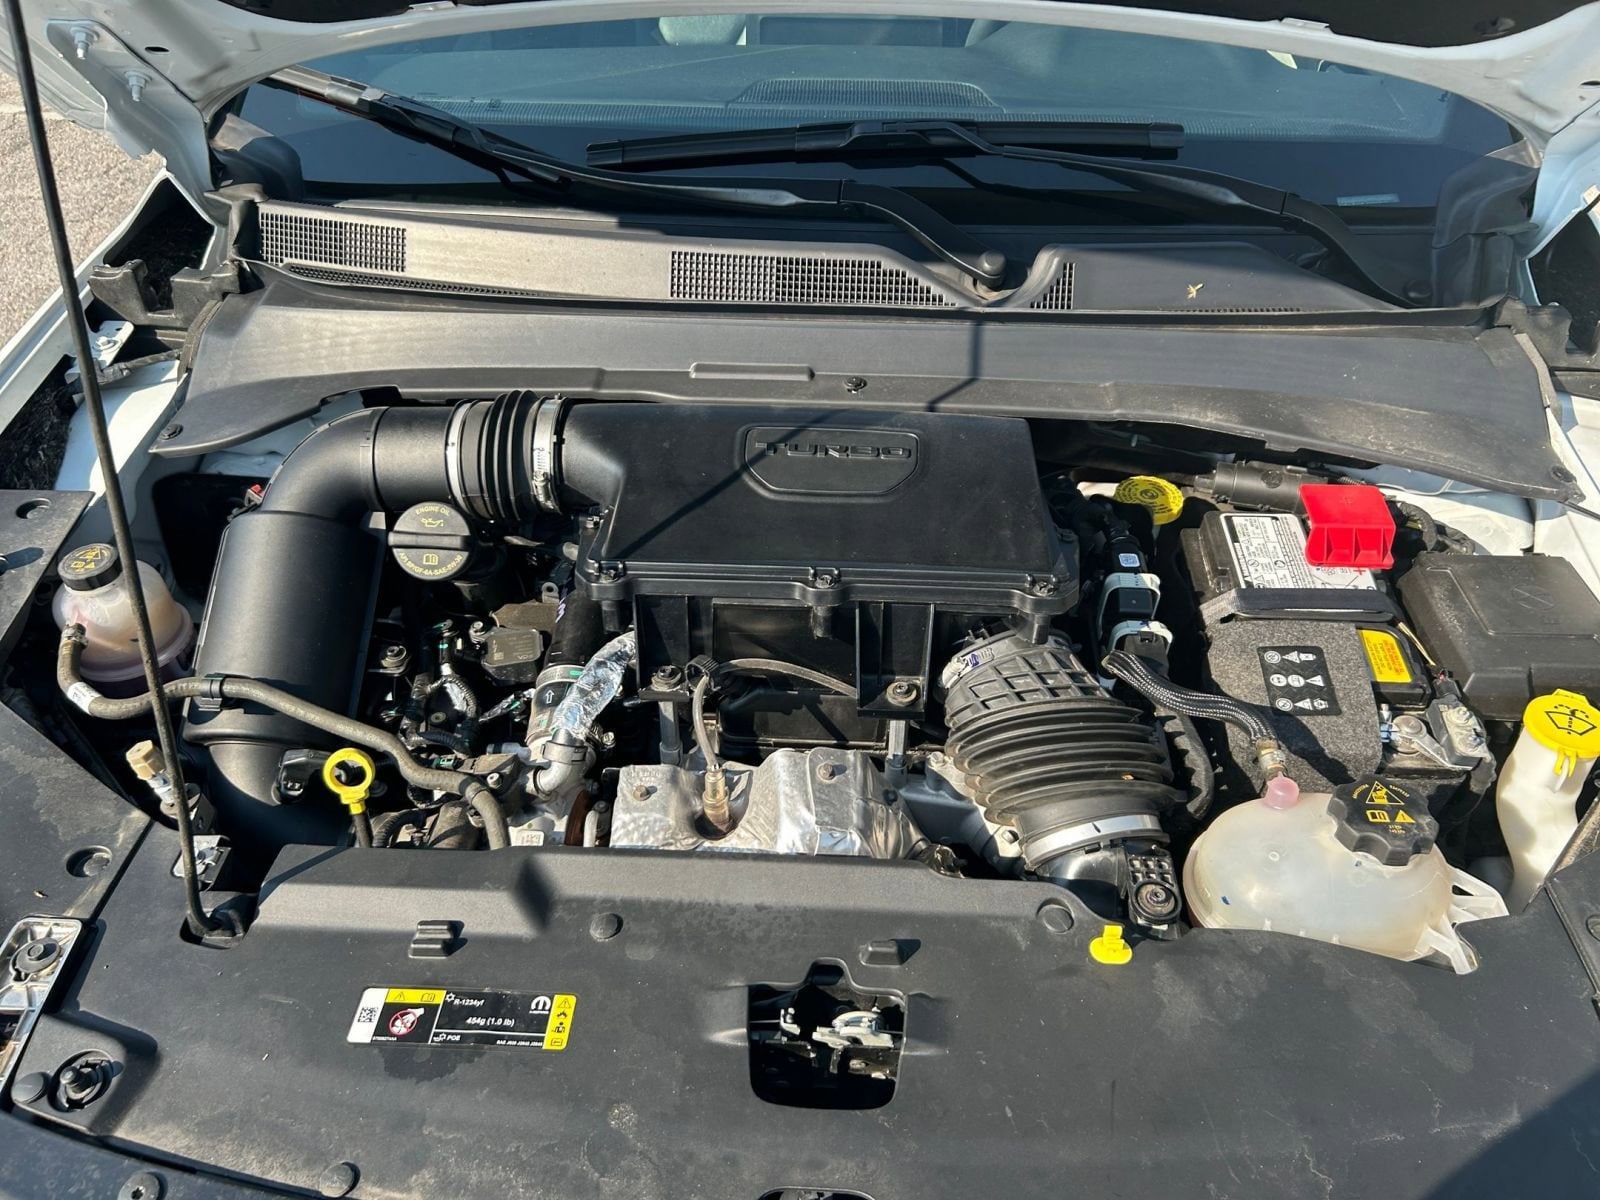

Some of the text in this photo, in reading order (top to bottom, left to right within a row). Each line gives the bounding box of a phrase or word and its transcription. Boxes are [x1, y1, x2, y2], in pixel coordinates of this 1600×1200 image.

[755, 442, 911, 460] TURBO
[415, 506, 450, 516] ENGINE OIL
[453, 998, 485, 1008] R-1234yf
[465, 1016, 515, 1028] 454g (1.0 lb)
[446, 1034, 461, 1042] POE
